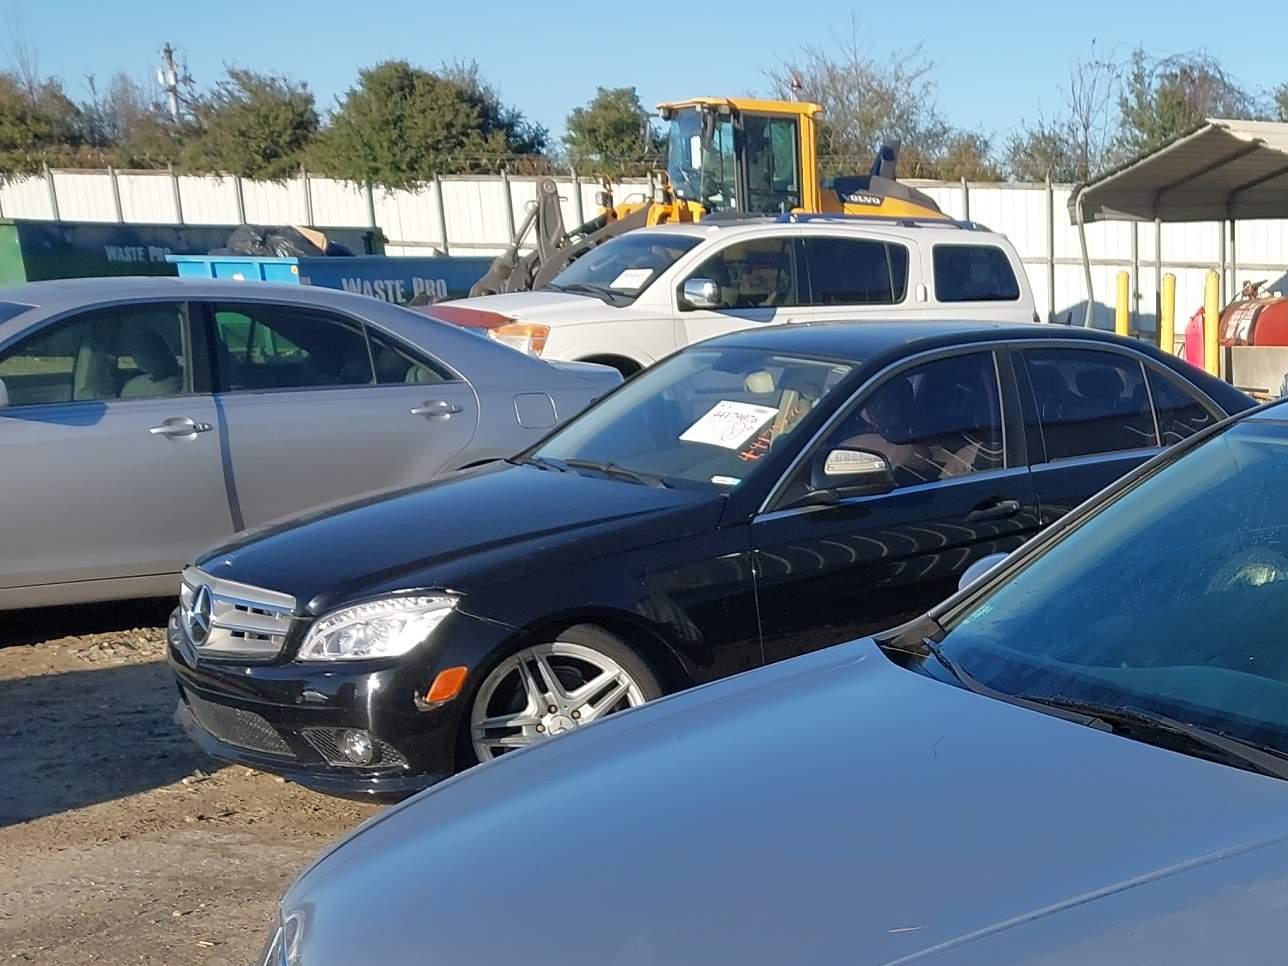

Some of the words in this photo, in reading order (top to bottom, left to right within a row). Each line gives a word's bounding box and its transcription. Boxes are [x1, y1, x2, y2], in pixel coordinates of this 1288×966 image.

[841, 192, 880, 204] VOLVO
[105, 246, 145, 262] WASTE
[341, 278, 405, 303] WASTE
[412, 277, 447, 298] PRO
